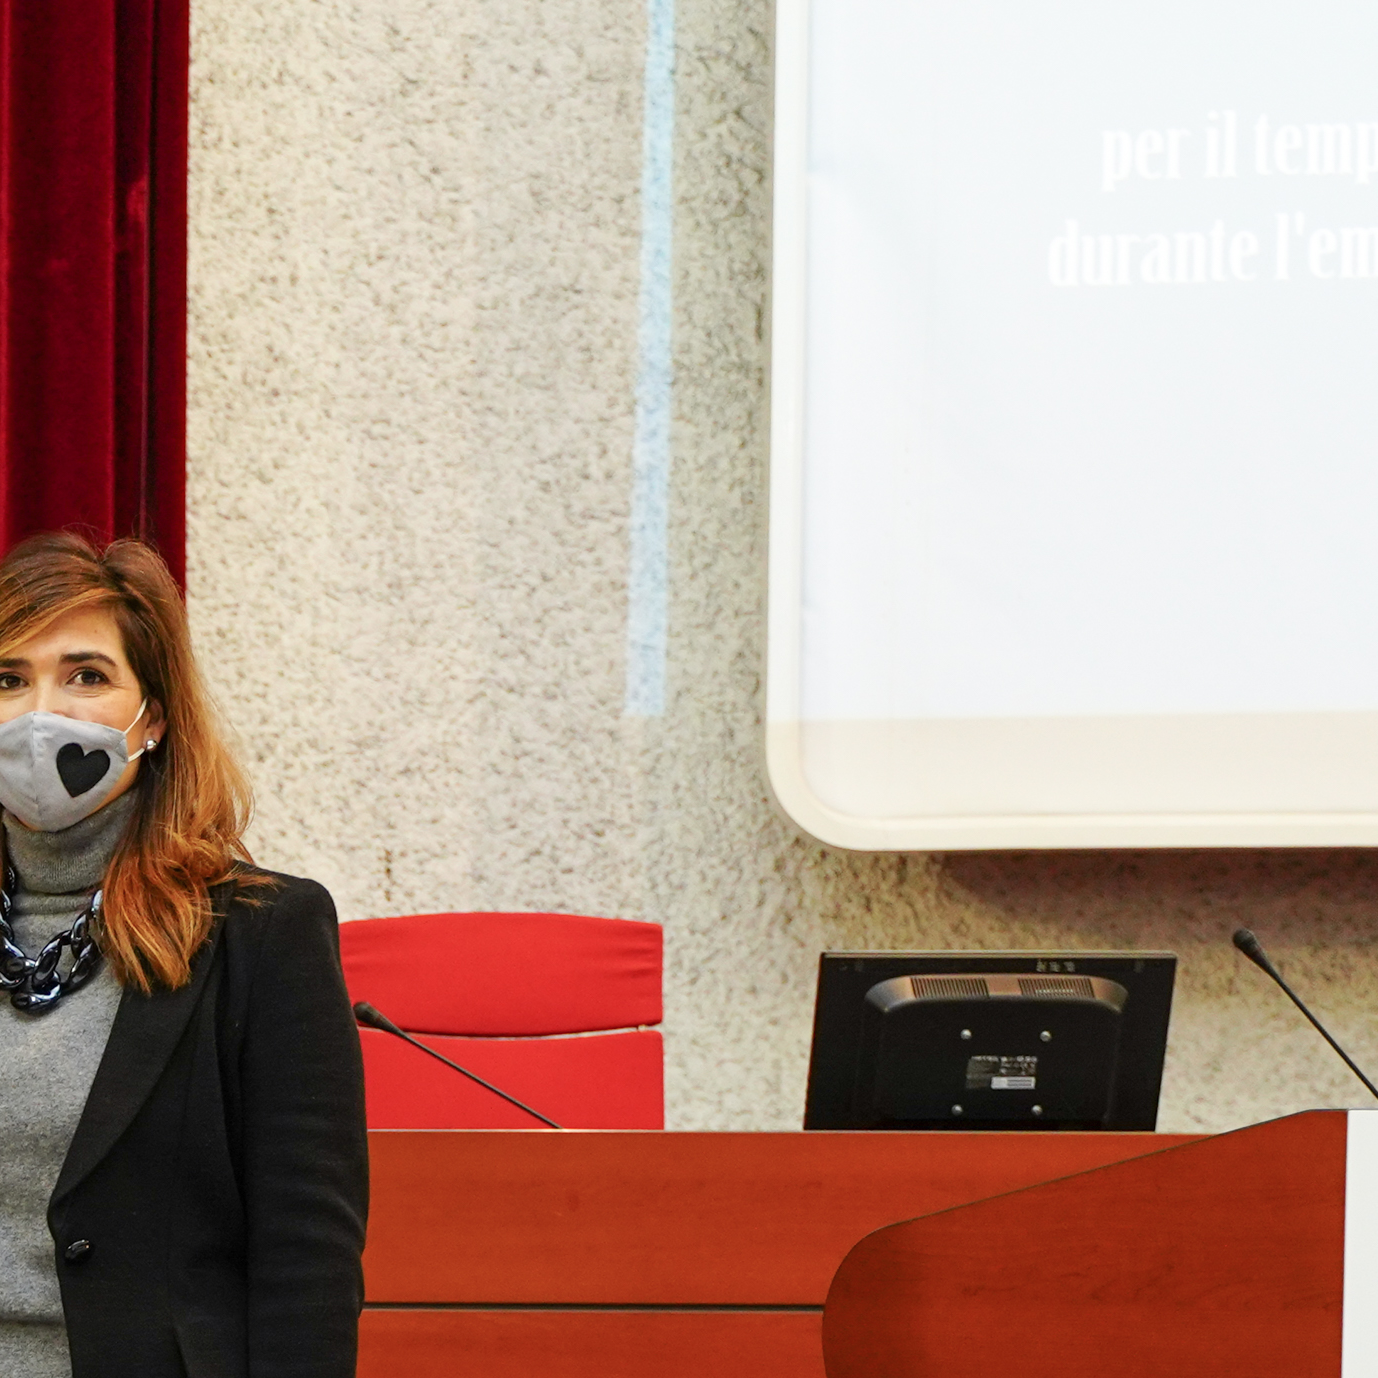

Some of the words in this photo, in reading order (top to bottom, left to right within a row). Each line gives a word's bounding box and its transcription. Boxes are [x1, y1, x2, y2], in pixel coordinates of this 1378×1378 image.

[1101, 124, 1191, 193] per
[1203, 109, 1238, 178] il
[1046, 217, 1260, 288] durante
